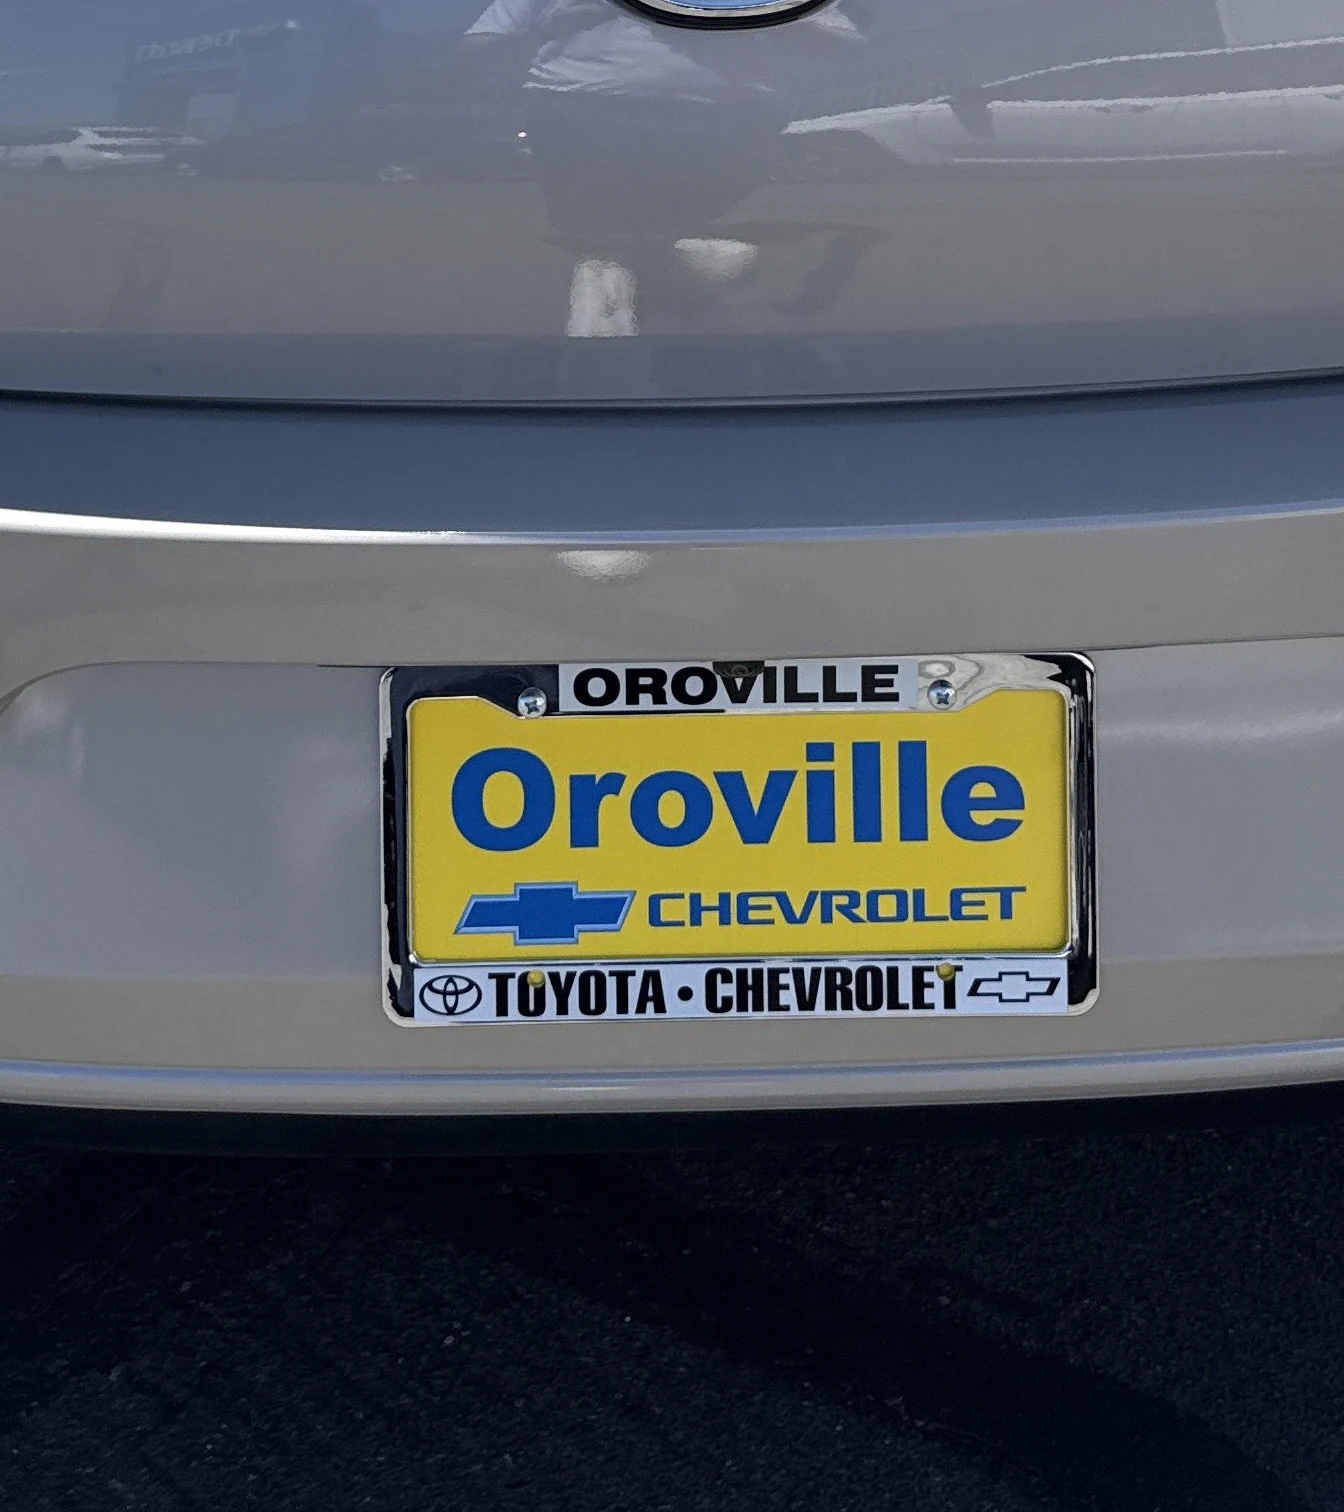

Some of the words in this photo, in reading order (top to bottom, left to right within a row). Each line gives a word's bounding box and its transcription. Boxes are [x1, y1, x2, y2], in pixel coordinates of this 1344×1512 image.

[572, 664, 900, 707] OROVILLE
[450, 739, 1027, 852] Oroville
[646, 885, 1027, 929] CHEVROLET
[488, 969, 667, 1018] TOYOTA
[704, 964, 964, 1014] CHEVROLET
